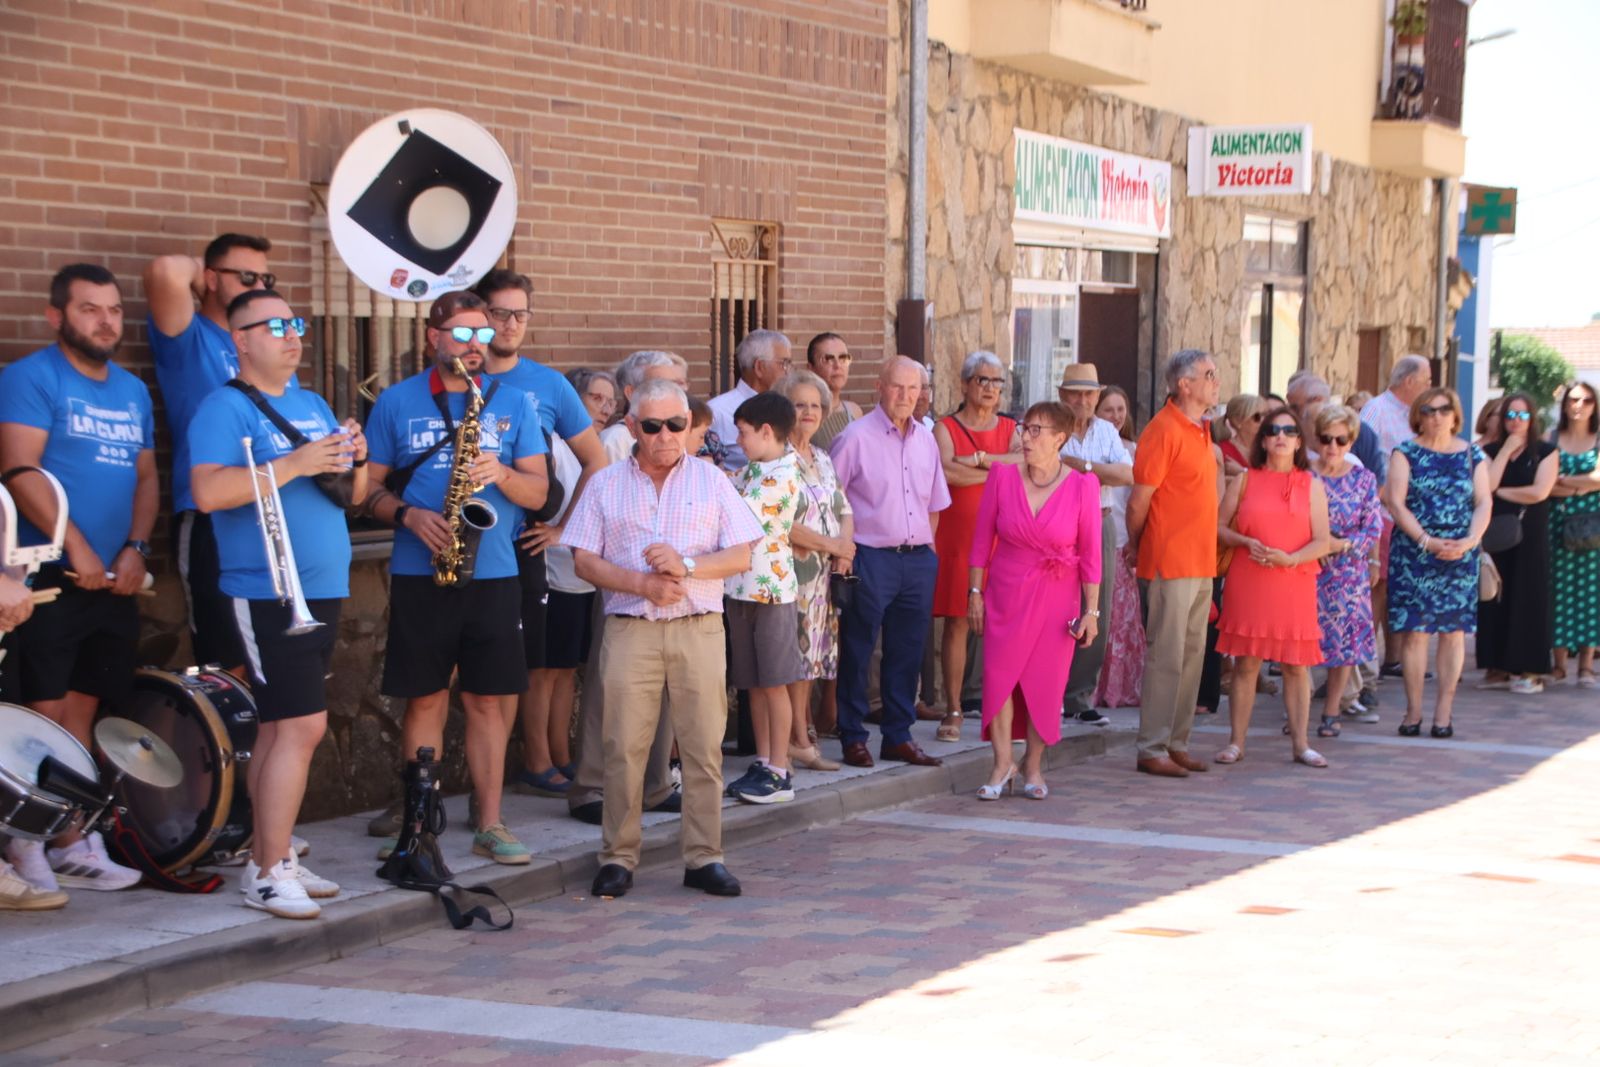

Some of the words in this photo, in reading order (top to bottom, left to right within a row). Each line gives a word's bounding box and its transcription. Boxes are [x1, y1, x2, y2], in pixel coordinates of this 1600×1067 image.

[1210, 131, 1302, 157] ALIMENTACION
[1015, 137, 1098, 220] ALIMENTACION
[1101, 157, 1149, 226] Victoria
[1217, 161, 1293, 187] Victoria
[73, 414, 96, 434] LA
[412, 431, 436, 449] LA
